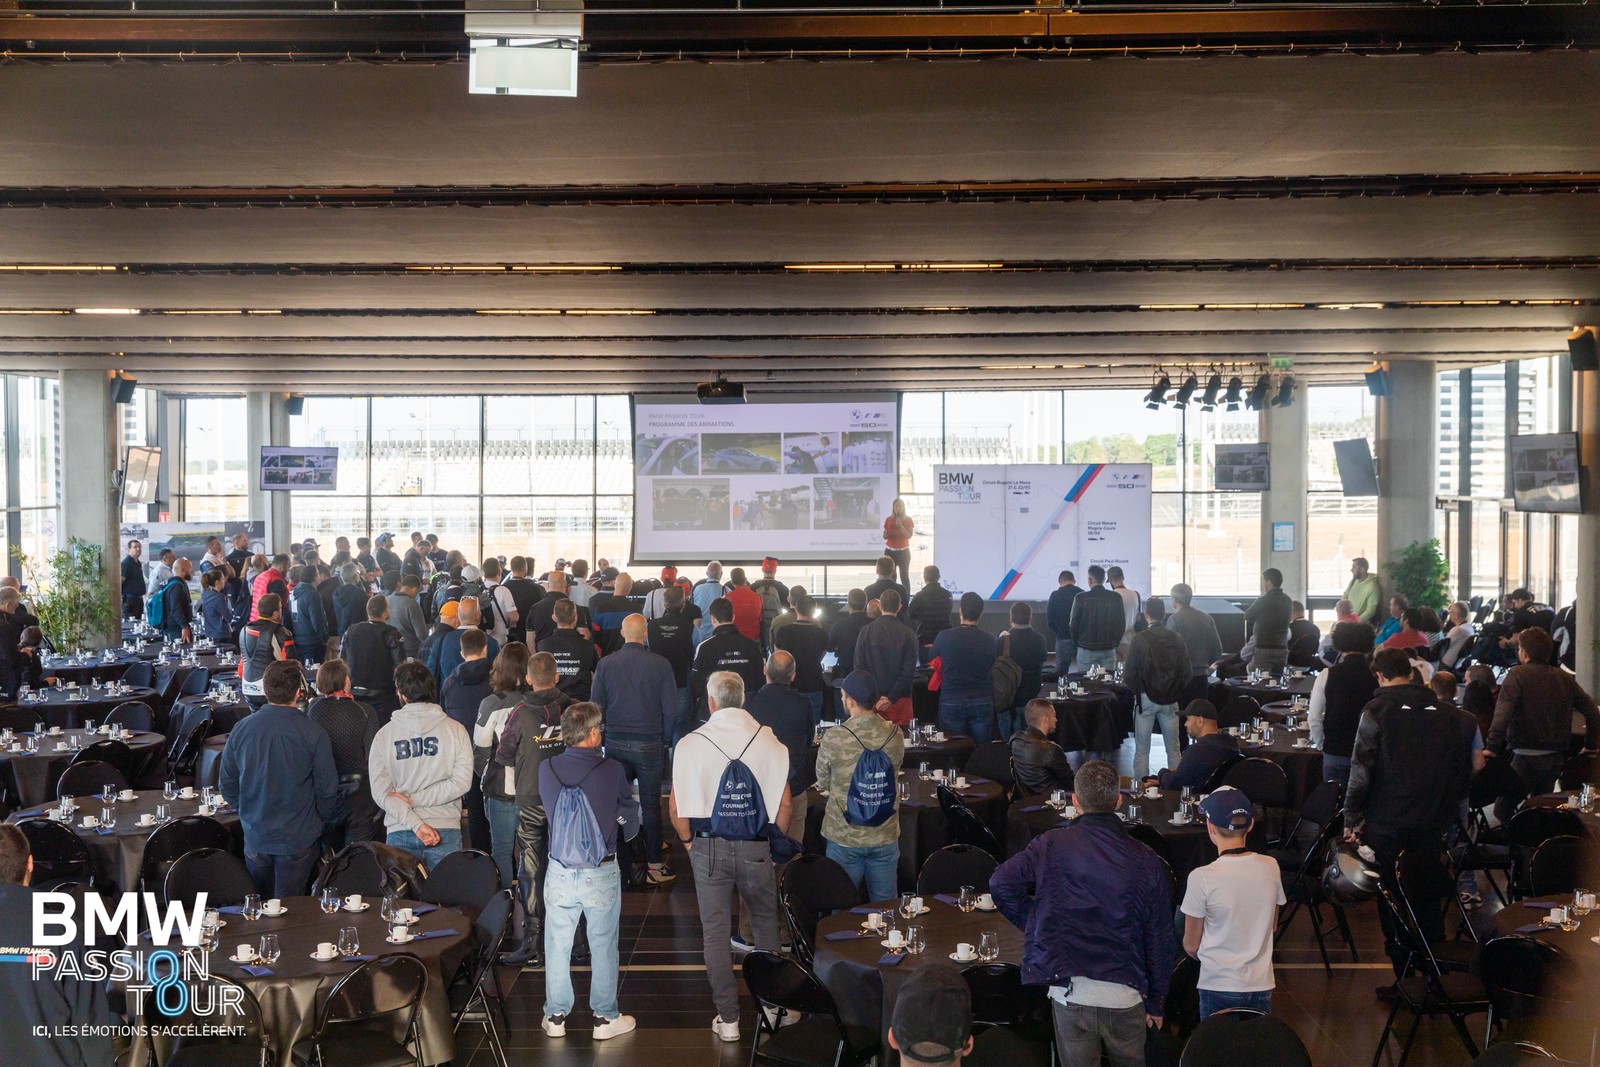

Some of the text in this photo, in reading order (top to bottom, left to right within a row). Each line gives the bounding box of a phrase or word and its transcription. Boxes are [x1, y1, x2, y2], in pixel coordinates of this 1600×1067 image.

[939, 473, 974, 485] BMW
[939, 485, 975, 493] PASSION
[958, 492, 981, 500] TOUR
[394, 736, 439, 761] BDS
[0, 946, 20, 954] BMW
